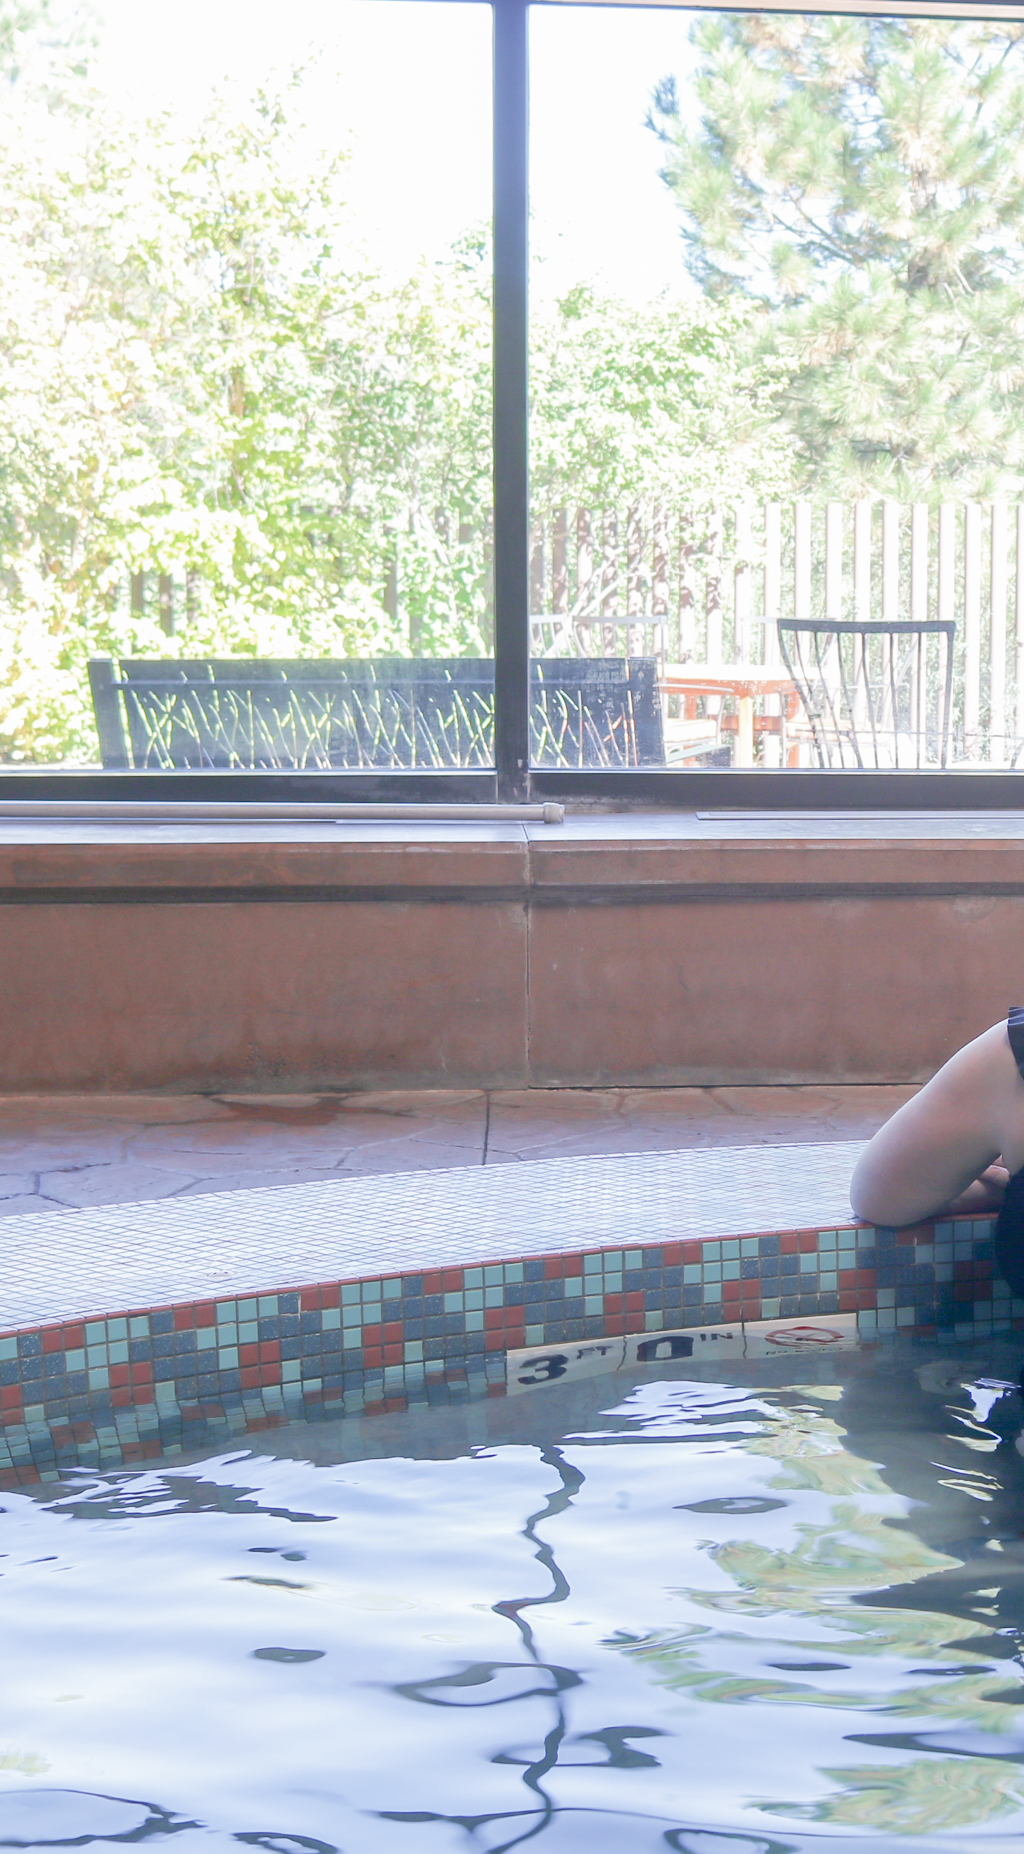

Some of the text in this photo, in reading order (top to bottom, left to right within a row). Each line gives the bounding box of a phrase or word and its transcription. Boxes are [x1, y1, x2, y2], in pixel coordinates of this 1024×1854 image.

[517, 1332, 733, 1385] 3 FT 0 IN
